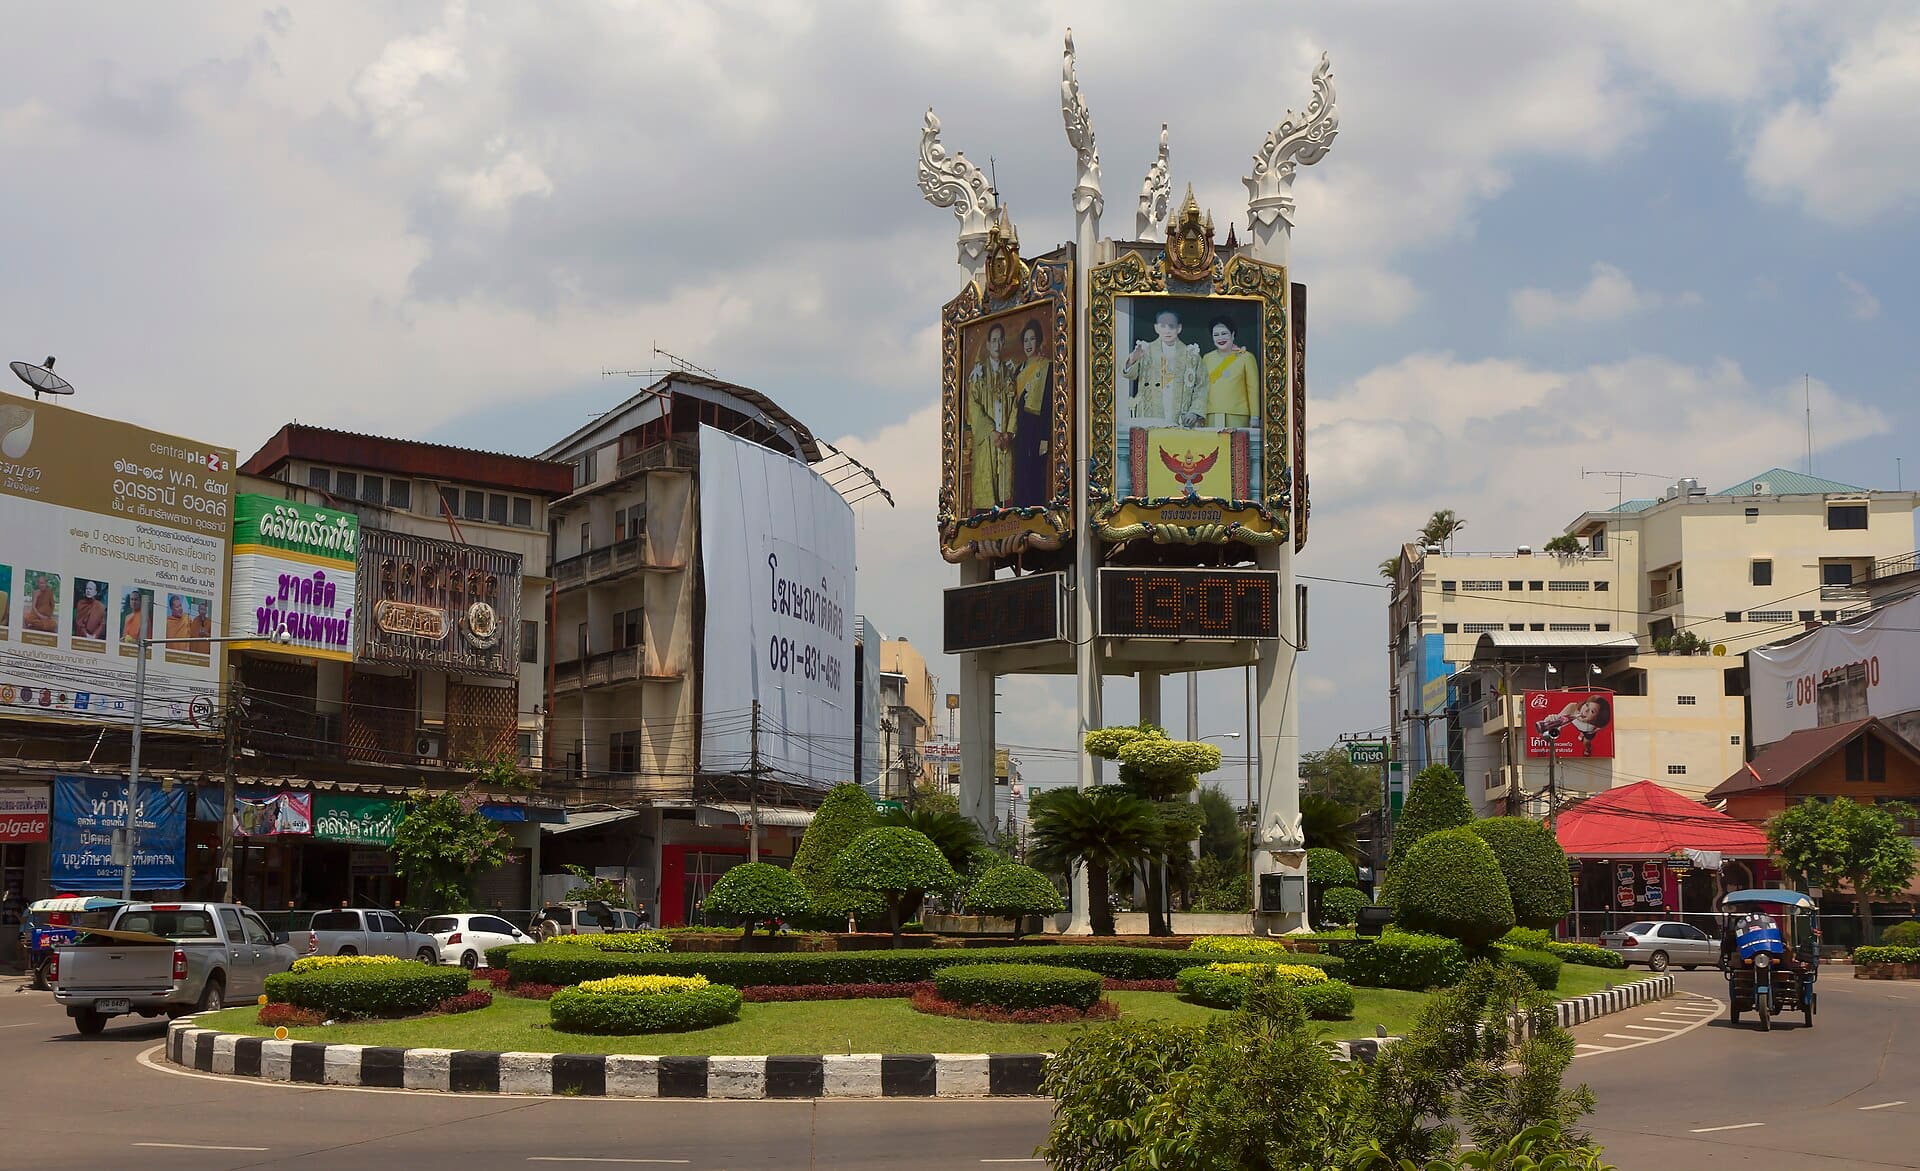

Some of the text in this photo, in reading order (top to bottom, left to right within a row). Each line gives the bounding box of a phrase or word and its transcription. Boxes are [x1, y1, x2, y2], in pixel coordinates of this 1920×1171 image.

[169, 469, 198, 489] พ.ค.
[113, 479, 227, 517] อุดรธานี ฮอลล์
[1160, 505, 1222, 524] ทรงพระเจริญ
[102, 532, 135, 547] อุดรธานี
[259, 505, 355, 554] คลินิกรักฟัน
[256, 594, 352, 646] ทันตแพทย์
[1125, 577, 1270, 630] 13:07
[1796, 673, 1817, 706] 081
[0, 818, 45, 837] olgate
